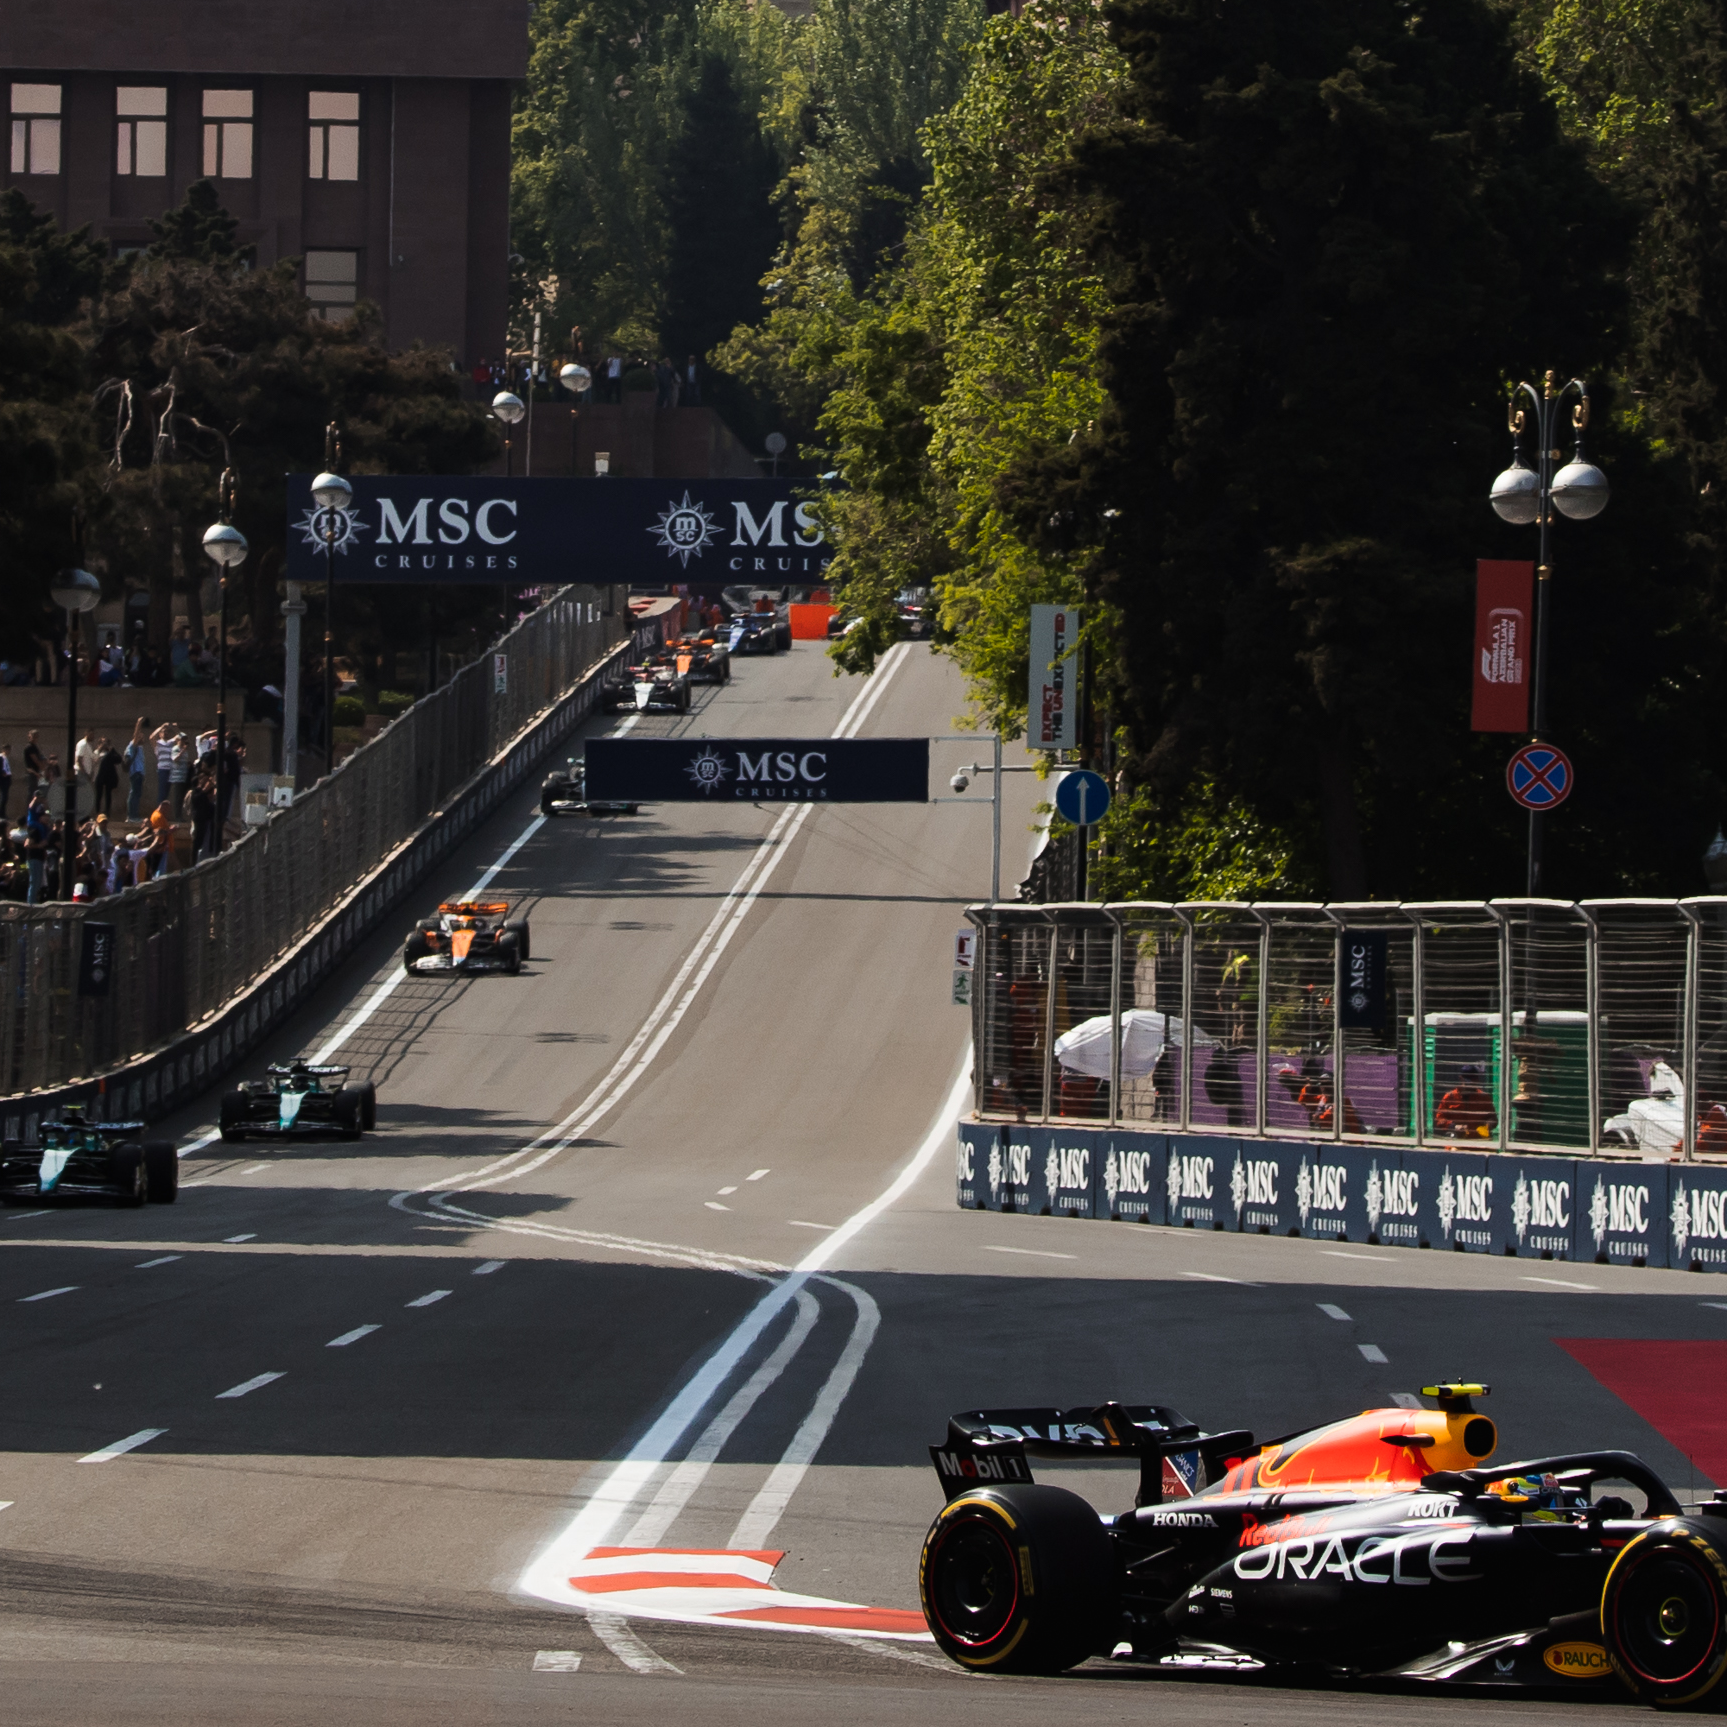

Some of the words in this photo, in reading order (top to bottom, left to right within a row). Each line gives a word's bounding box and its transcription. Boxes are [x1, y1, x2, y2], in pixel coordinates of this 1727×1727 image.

[376, 498, 517, 545] MSC
[730, 501, 825, 547] MS
[375, 554, 517, 569] CRUISES
[1041, 684, 1053, 742] EXPECT
[1053, 712, 1064, 742] THE
[736, 752, 828, 782] MSC
[736, 787, 828, 797] CRUISES
[1350, 945, 1365, 989] MSC
[1001, 1144, 1031, 1186] MSC
[1059, 1148, 1089, 1190] MSC
[1119, 1151, 1150, 1194] MSC
[1182, 1155, 1214, 1200] MSC
[1246, 1160, 1279, 1205] MSC
[1312, 1164, 1347, 1212] MSC
[1383, 1169, 1419, 1216] MSC
[1456, 1174, 1493, 1222] MSC
[1530, 1179, 1570, 1229] MSC
[1609, 1184, 1649, 1234] MSC
[938, 1451, 1005, 1480] Mobil
[1010, 1458, 1022, 1477] 1
[1152, 1513, 1219, 1528] HONDA
[1239, 1513, 1290, 1547] Red
[1408, 1499, 1460, 1519] ROKT
[1234, 1532, 1485, 1586] ORACLE
[1563, 1650, 1609, 1668] RAUCH
